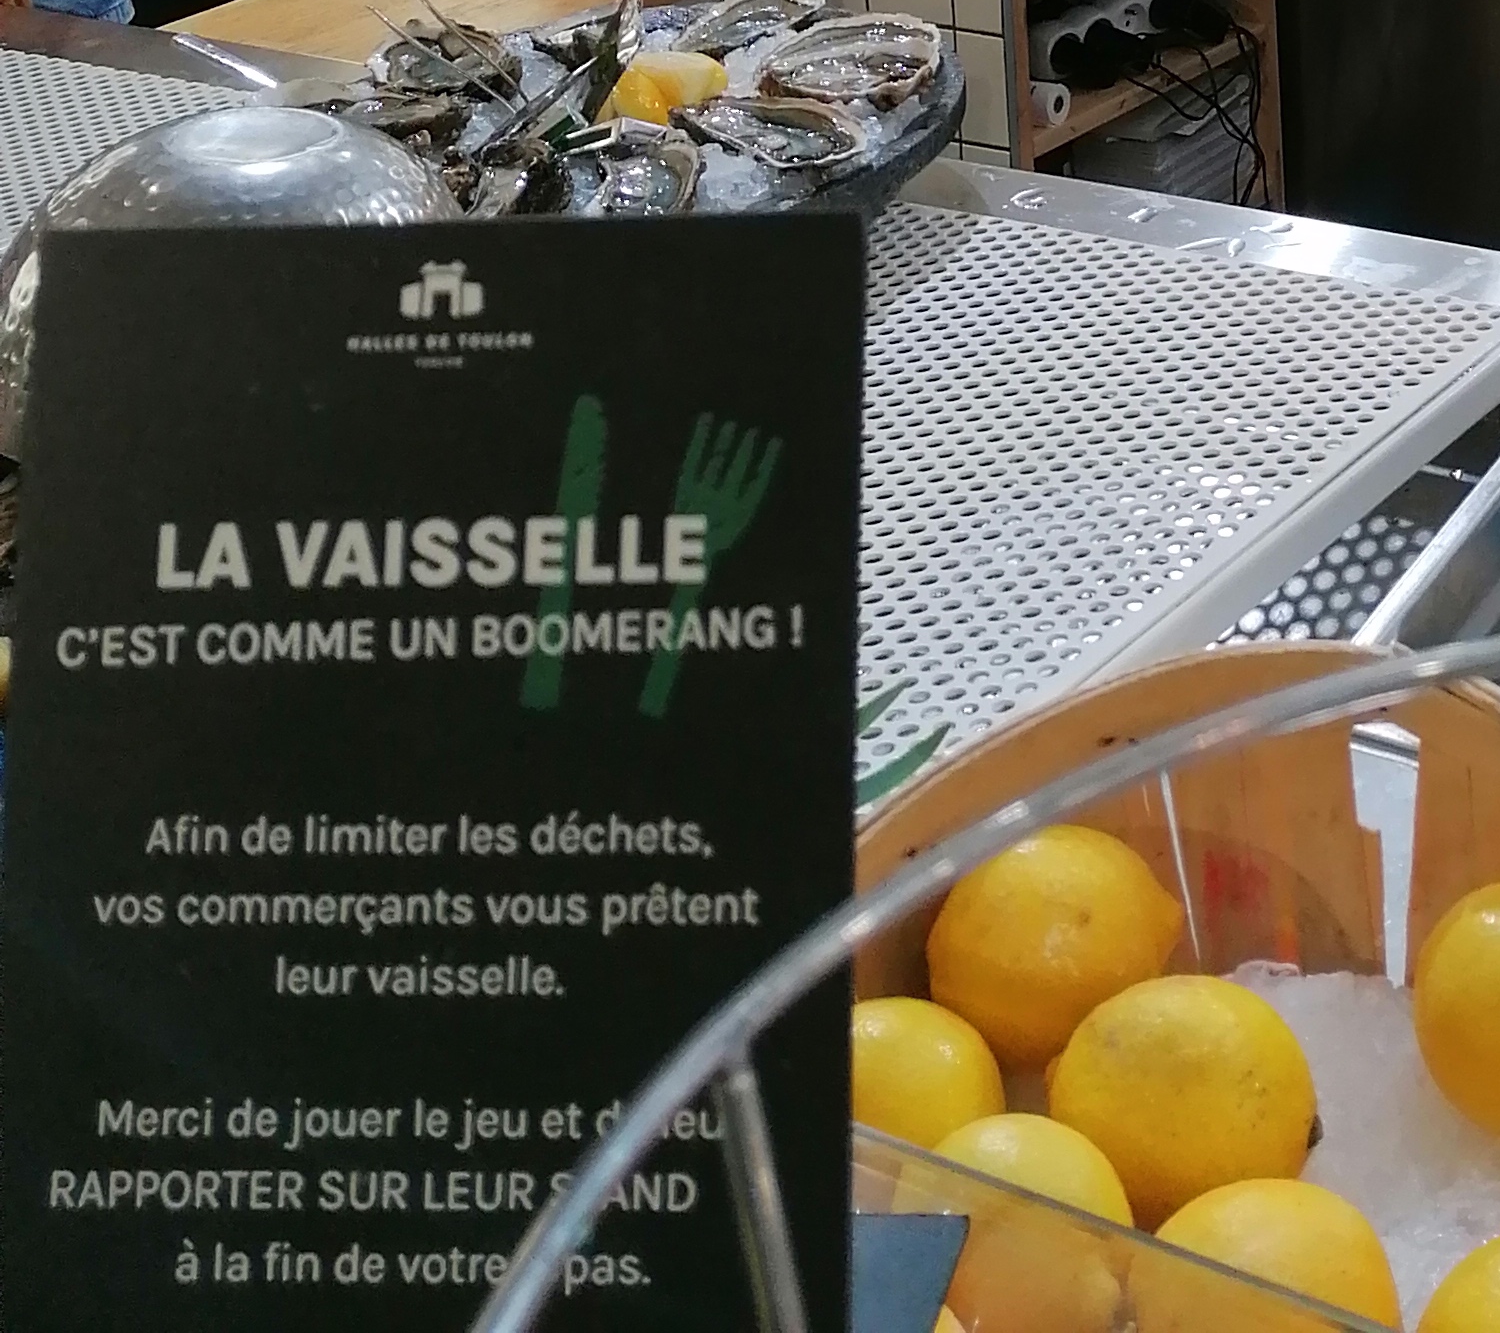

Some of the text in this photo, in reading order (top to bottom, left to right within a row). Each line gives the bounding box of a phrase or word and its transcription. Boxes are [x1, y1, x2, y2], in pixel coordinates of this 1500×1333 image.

[156, 514, 708, 590] LA VAISSELLE
[57, 625, 186, 669] C'EST
[196, 619, 374, 665] COMME
[390, 618, 456, 659] UN
[472, 605, 775, 658] BOOMERANG
[146, 811, 713, 858] Afin de limiter les déchets,
[93, 884, 759, 936] vos commerçants vous prêtent
[276, 955, 565, 996] leur vaisselle.
[98, 1097, 213, 1138] Merci
[227, 1098, 278, 1138] de
[285, 1097, 402, 1151] jouer
[415, 1098, 449, 1138] le
[456, 1098, 527, 1151] jeu
[541, 1103, 582, 1139] et
[50, 1170, 697, 1213] RAPPORTER SUR LEUR SAND
[175, 1238, 652, 1297] à la fin de votre pas.
